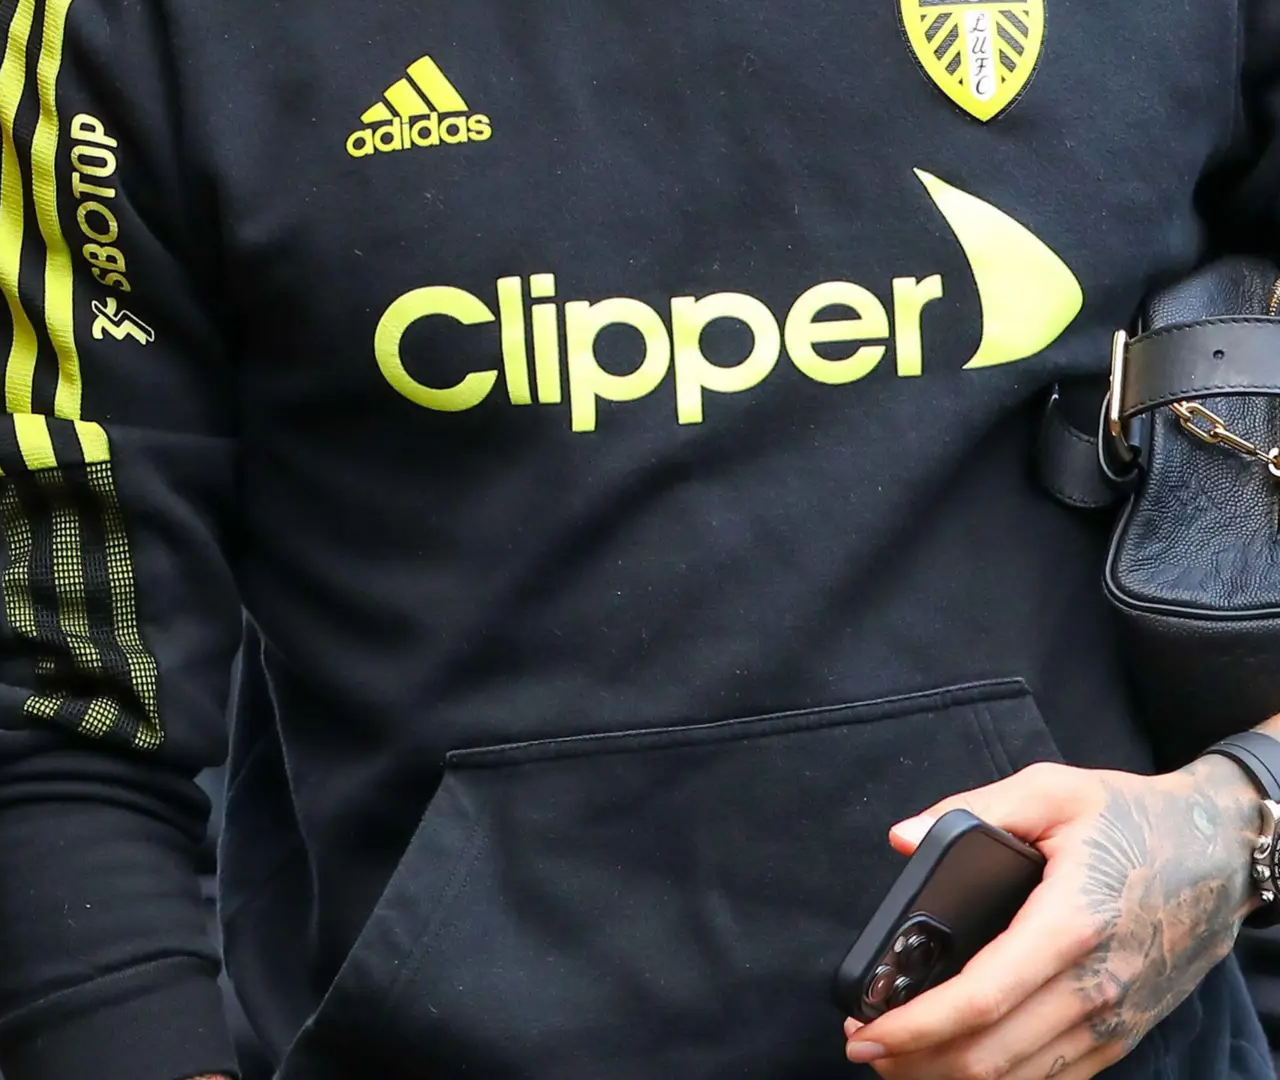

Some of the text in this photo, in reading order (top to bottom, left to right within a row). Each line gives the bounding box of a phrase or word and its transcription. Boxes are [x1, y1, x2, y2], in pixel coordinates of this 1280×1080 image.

[969, 12, 990, 95] LUFC
[345, 110, 493, 158] adidas
[70, 112, 132, 293] SBOTOP
[373, 272, 944, 433] Clipper
